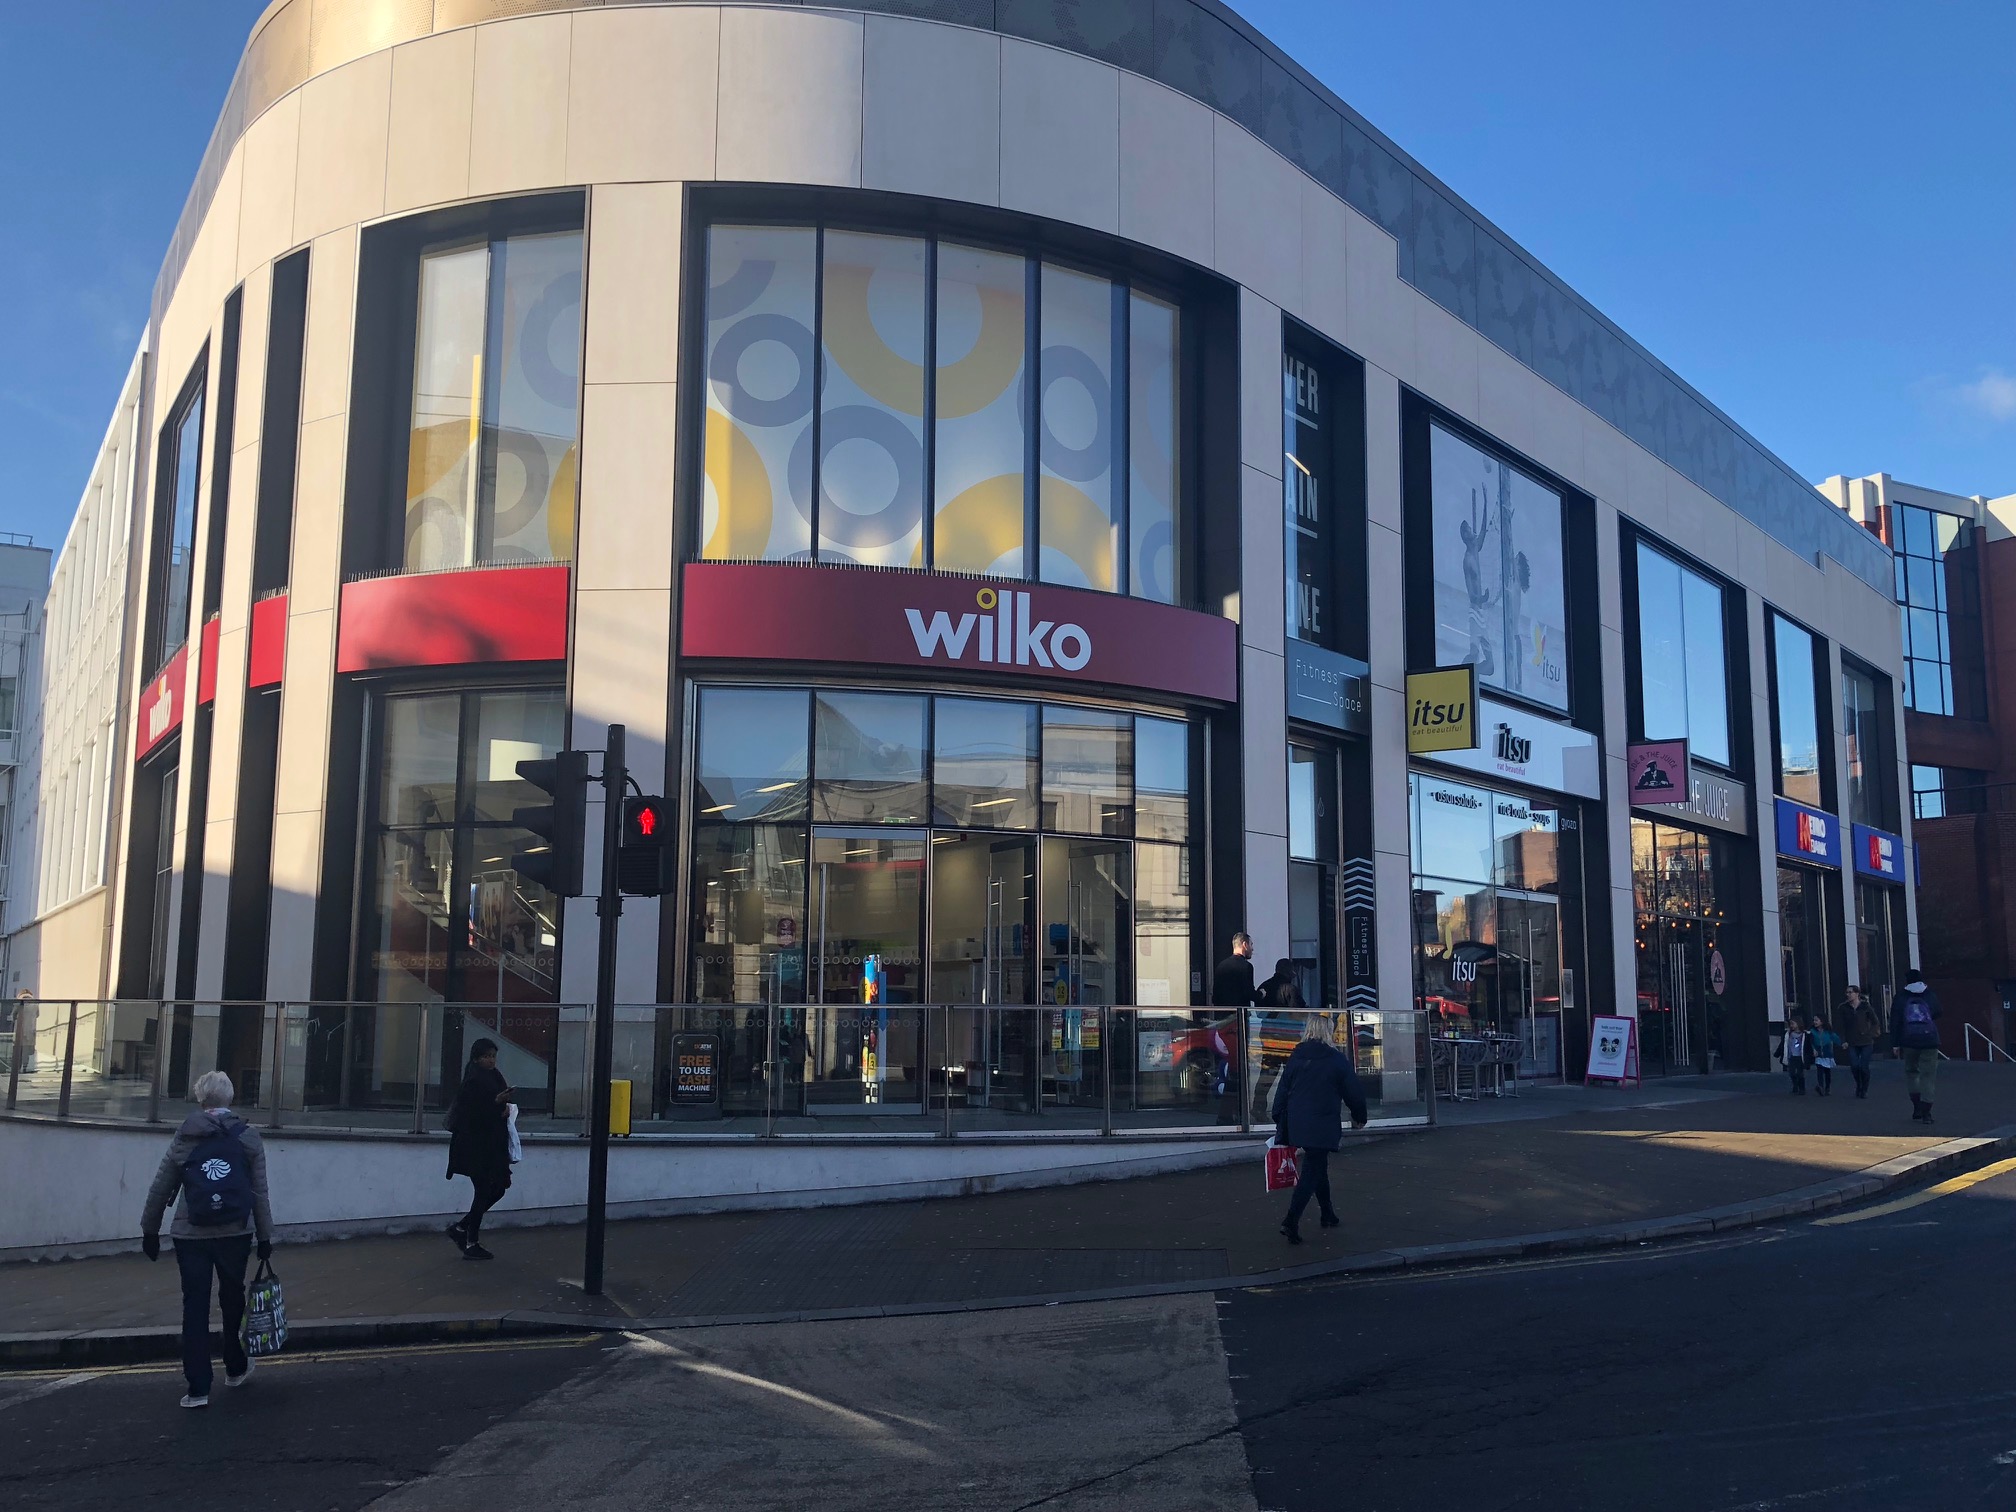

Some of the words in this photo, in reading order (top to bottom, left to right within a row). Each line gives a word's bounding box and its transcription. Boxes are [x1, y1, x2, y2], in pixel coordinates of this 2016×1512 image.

[904, 588, 1092, 671] wilko
[1296, 659, 1338, 685] Fitness
[1542, 655, 1561, 682] itsu
[1333, 691, 1361, 713] Space
[1412, 699, 1465, 727] itsu
[1412, 728, 1424, 736] eat
[1426, 724, 1463, 735] beautiful
[1493, 722, 1532, 764] itsu
[1660, 753, 1678, 769] JUICE
[1704, 783, 1730, 822] JUICE
[1361, 916, 1369, 954] Fitness
[1351, 949, 1361, 976] Space
[1452, 953, 1477, 982] itsu
[679, 1055, 711, 1067] FREE
[679, 1066, 692, 1075] TO
[693, 1066, 711, 1075] USE
[678, 1075, 711, 1085] CASH
